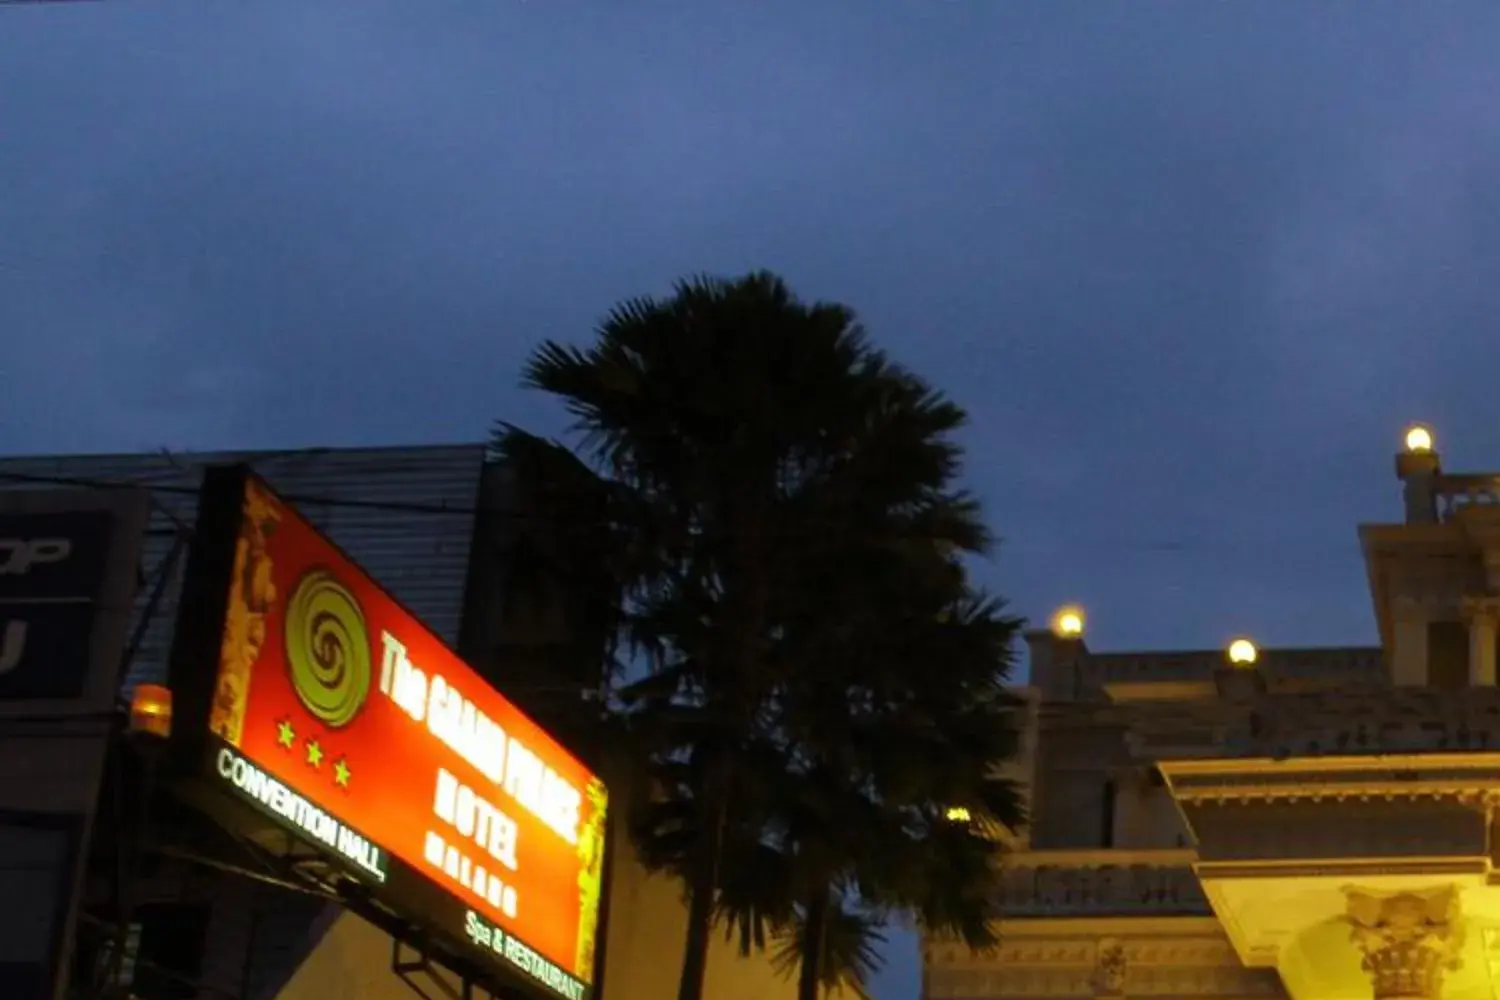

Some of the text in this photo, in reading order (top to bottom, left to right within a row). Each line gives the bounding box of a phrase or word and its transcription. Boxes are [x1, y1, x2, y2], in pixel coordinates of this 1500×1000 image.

[380, 629, 428, 721] The
[217, 748, 339, 847] CONVENTION
[433, 767, 518, 872] HOTEL
[424, 829, 517, 919] MALANG
[491, 928, 503, 954] &
